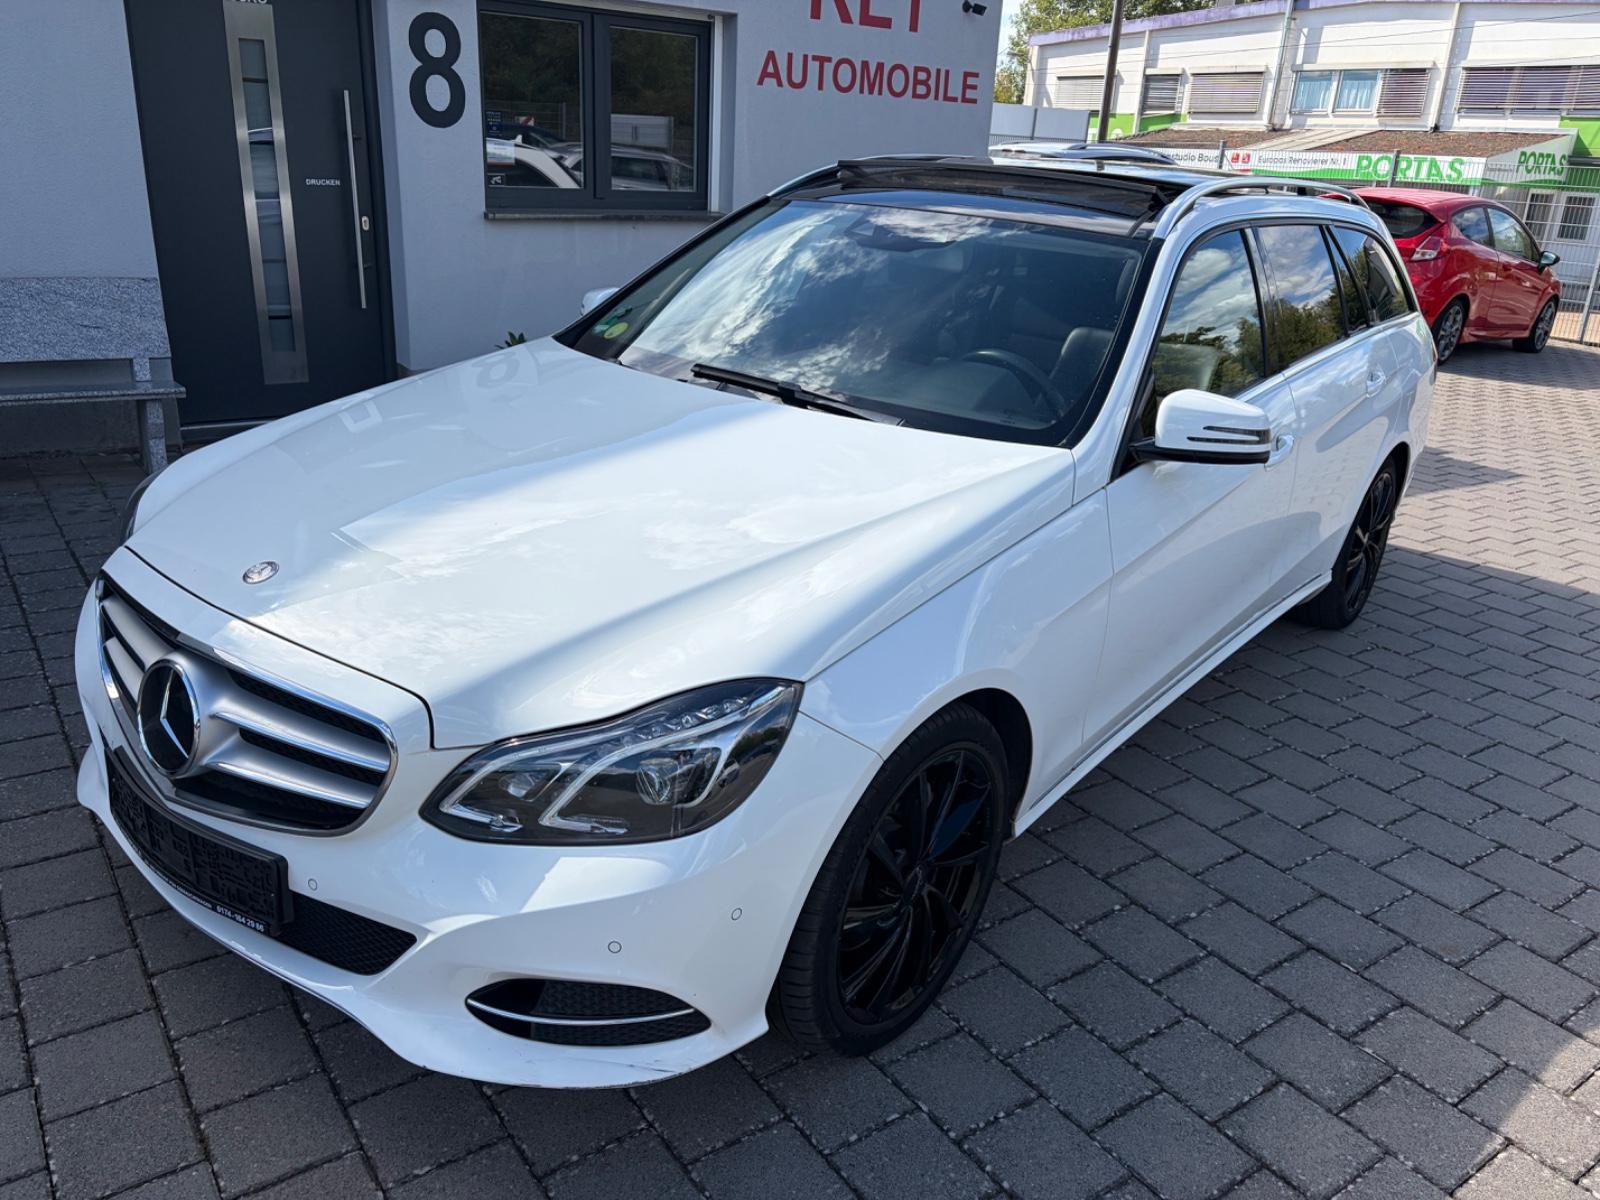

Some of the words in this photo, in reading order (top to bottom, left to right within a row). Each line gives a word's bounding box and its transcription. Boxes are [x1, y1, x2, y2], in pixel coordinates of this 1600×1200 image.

[408, 11, 466, 129] 8
[757, 49, 980, 105] AUTOMOBILE
[1355, 154, 1465, 182] PORTAS
[1515, 150, 1567, 176] PORTAS
